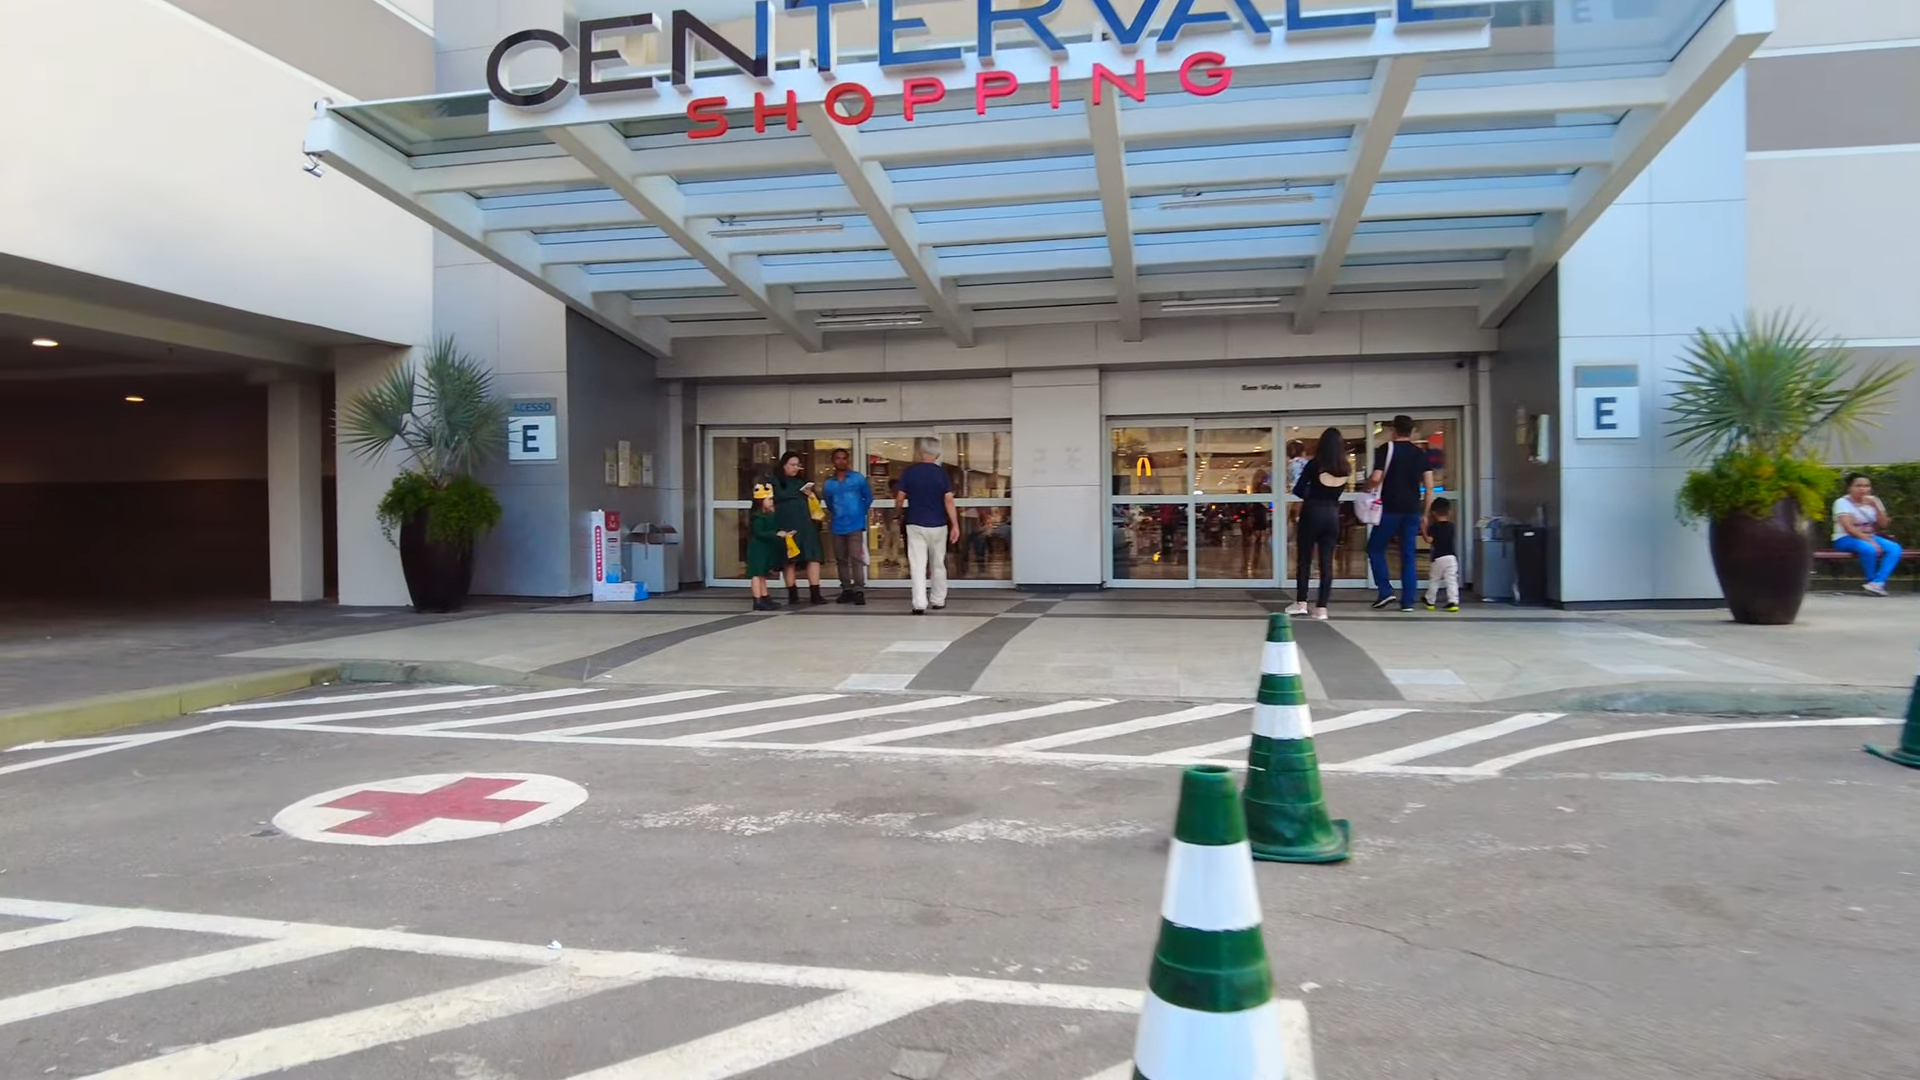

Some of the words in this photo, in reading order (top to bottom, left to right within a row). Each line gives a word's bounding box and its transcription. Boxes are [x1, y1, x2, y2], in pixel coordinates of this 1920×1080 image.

[686, 51, 1233, 139] SHOPPING
[512, 403, 552, 413] ACESSO
[1594, 397, 1617, 430] E
[522, 425, 539, 452] E
